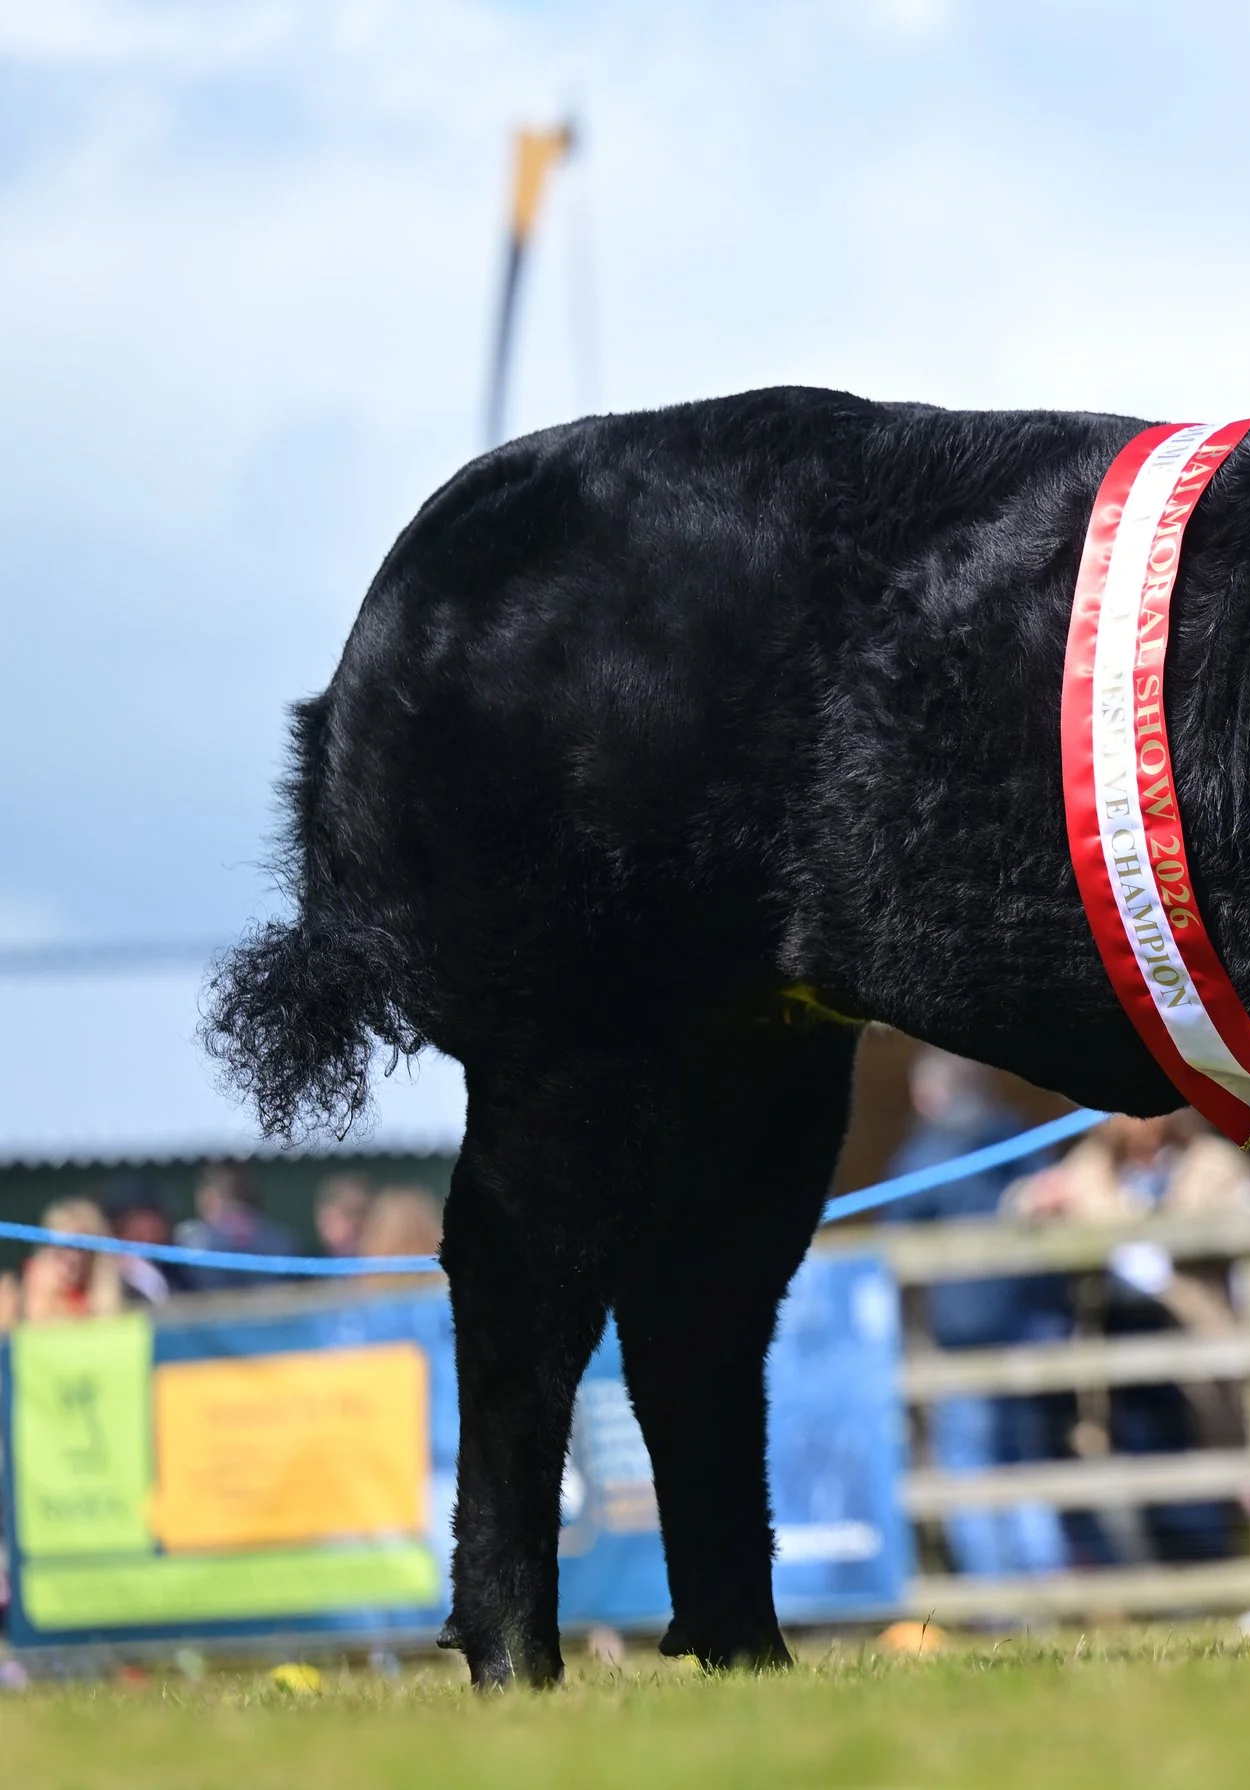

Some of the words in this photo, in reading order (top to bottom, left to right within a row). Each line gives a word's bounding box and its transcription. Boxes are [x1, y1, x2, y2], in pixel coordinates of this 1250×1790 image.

[1138, 443, 1234, 667] BALMORAL
[1135, 674, 1177, 822] SHOW
[1111, 828, 1193, 1009] CHAMPION
[1150, 835, 1200, 929] 2026
